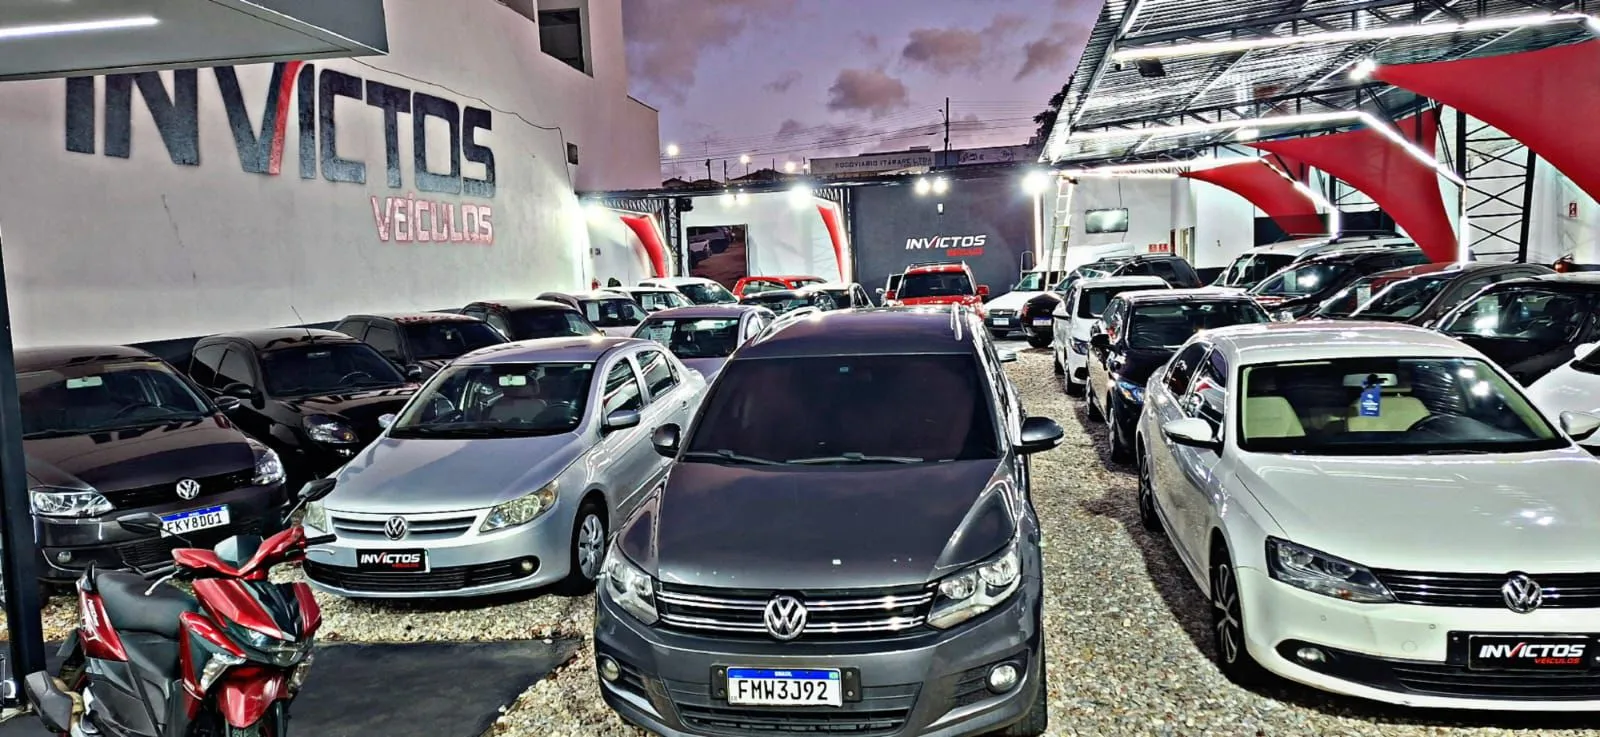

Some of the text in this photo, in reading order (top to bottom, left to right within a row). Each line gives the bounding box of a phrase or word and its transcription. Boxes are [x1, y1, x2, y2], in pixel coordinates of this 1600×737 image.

[65, 60, 497, 199] INVICTOS
[905, 234, 987, 250] INVICTOS
[360, 552, 421, 564] INVICTOS
[1479, 641, 1587, 658] INVICTOS
[738, 679, 829, 701] FMW3J92
